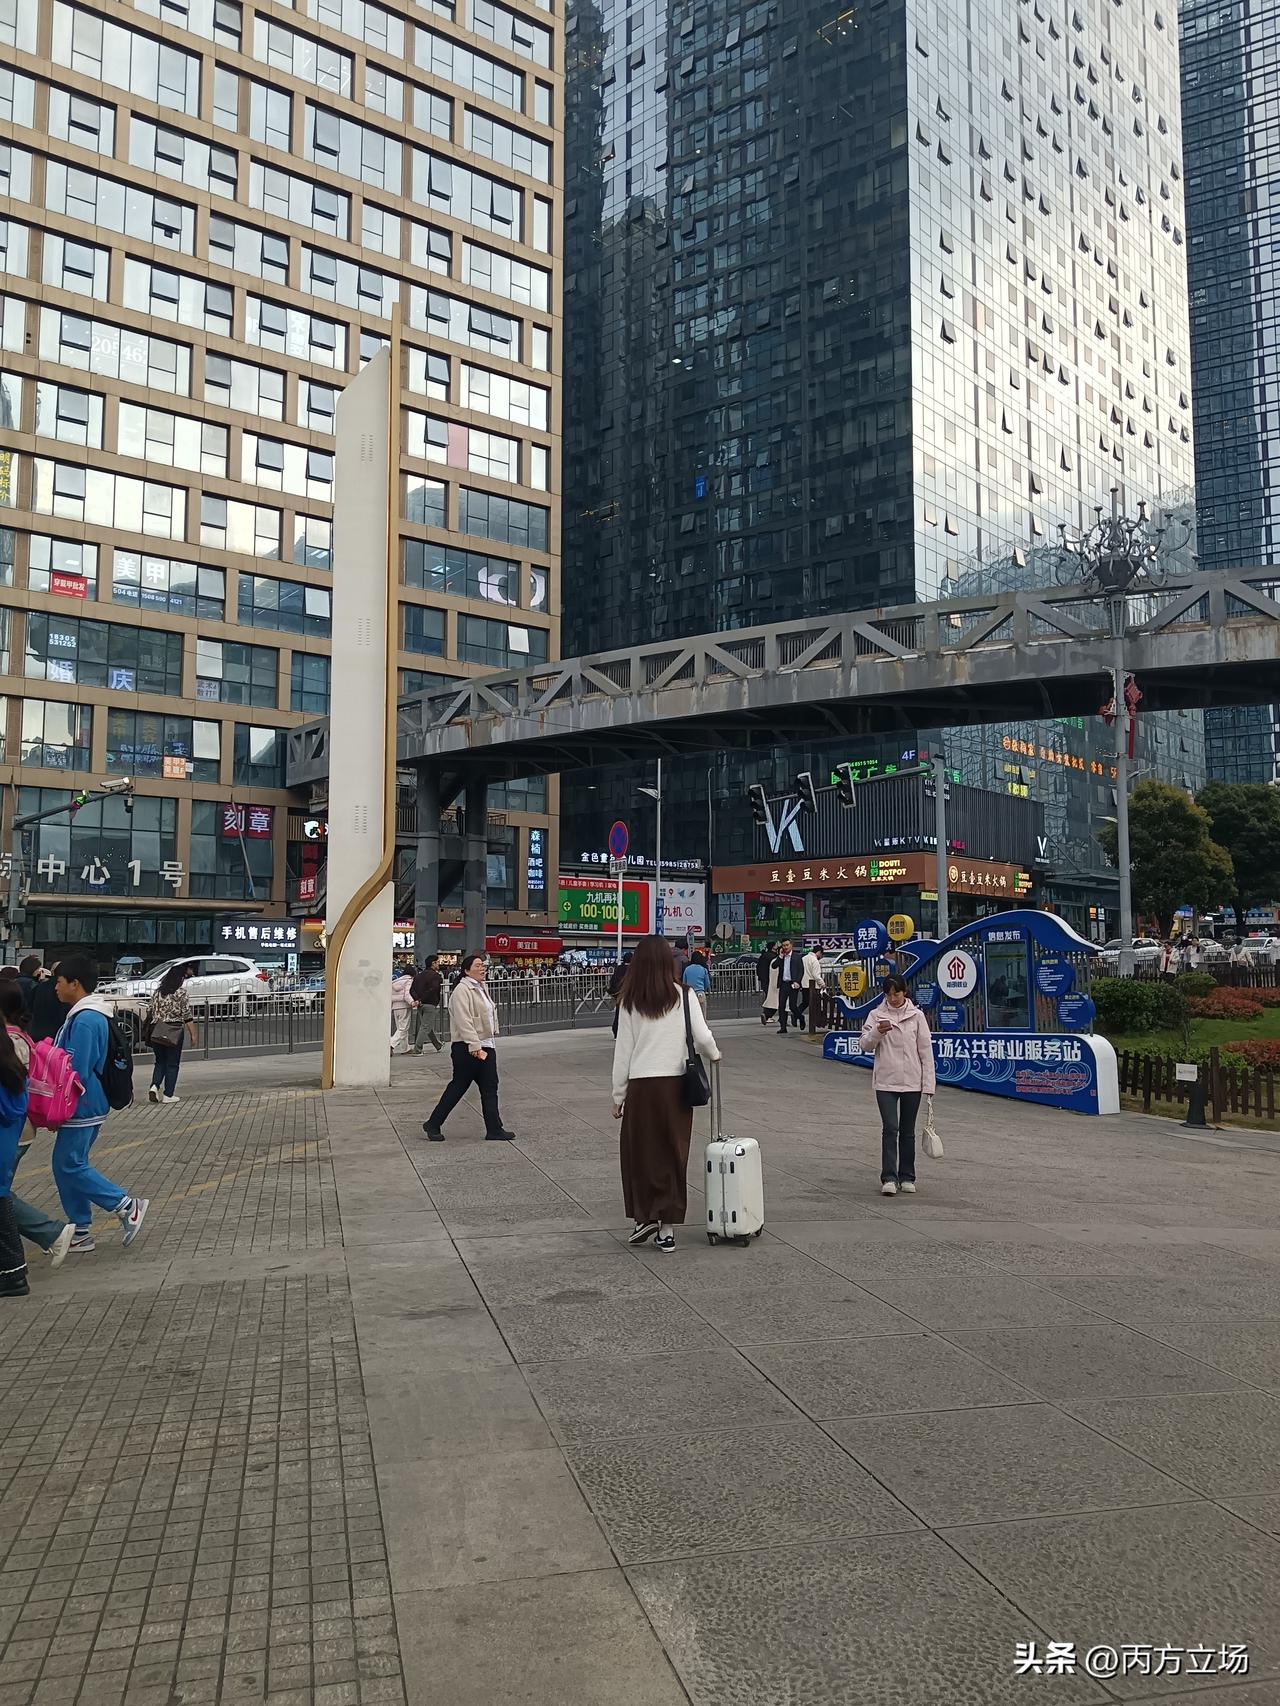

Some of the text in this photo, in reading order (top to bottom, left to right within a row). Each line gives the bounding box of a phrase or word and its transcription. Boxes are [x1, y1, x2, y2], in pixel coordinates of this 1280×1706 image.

[116, 557, 166, 584] 美甲
[902, 750, 916, 760] 4F
[224, 809, 270, 833] 刻章
[879, 868, 906, 876] HOTPOT
[221, 925, 297, 941] 手机售后维修
[858, 927, 878, 941] 免费
[988, 931, 1021, 941] 信息发布
[858, 941, 878, 950] 找工作
[844, 971, 859, 982] 免费
